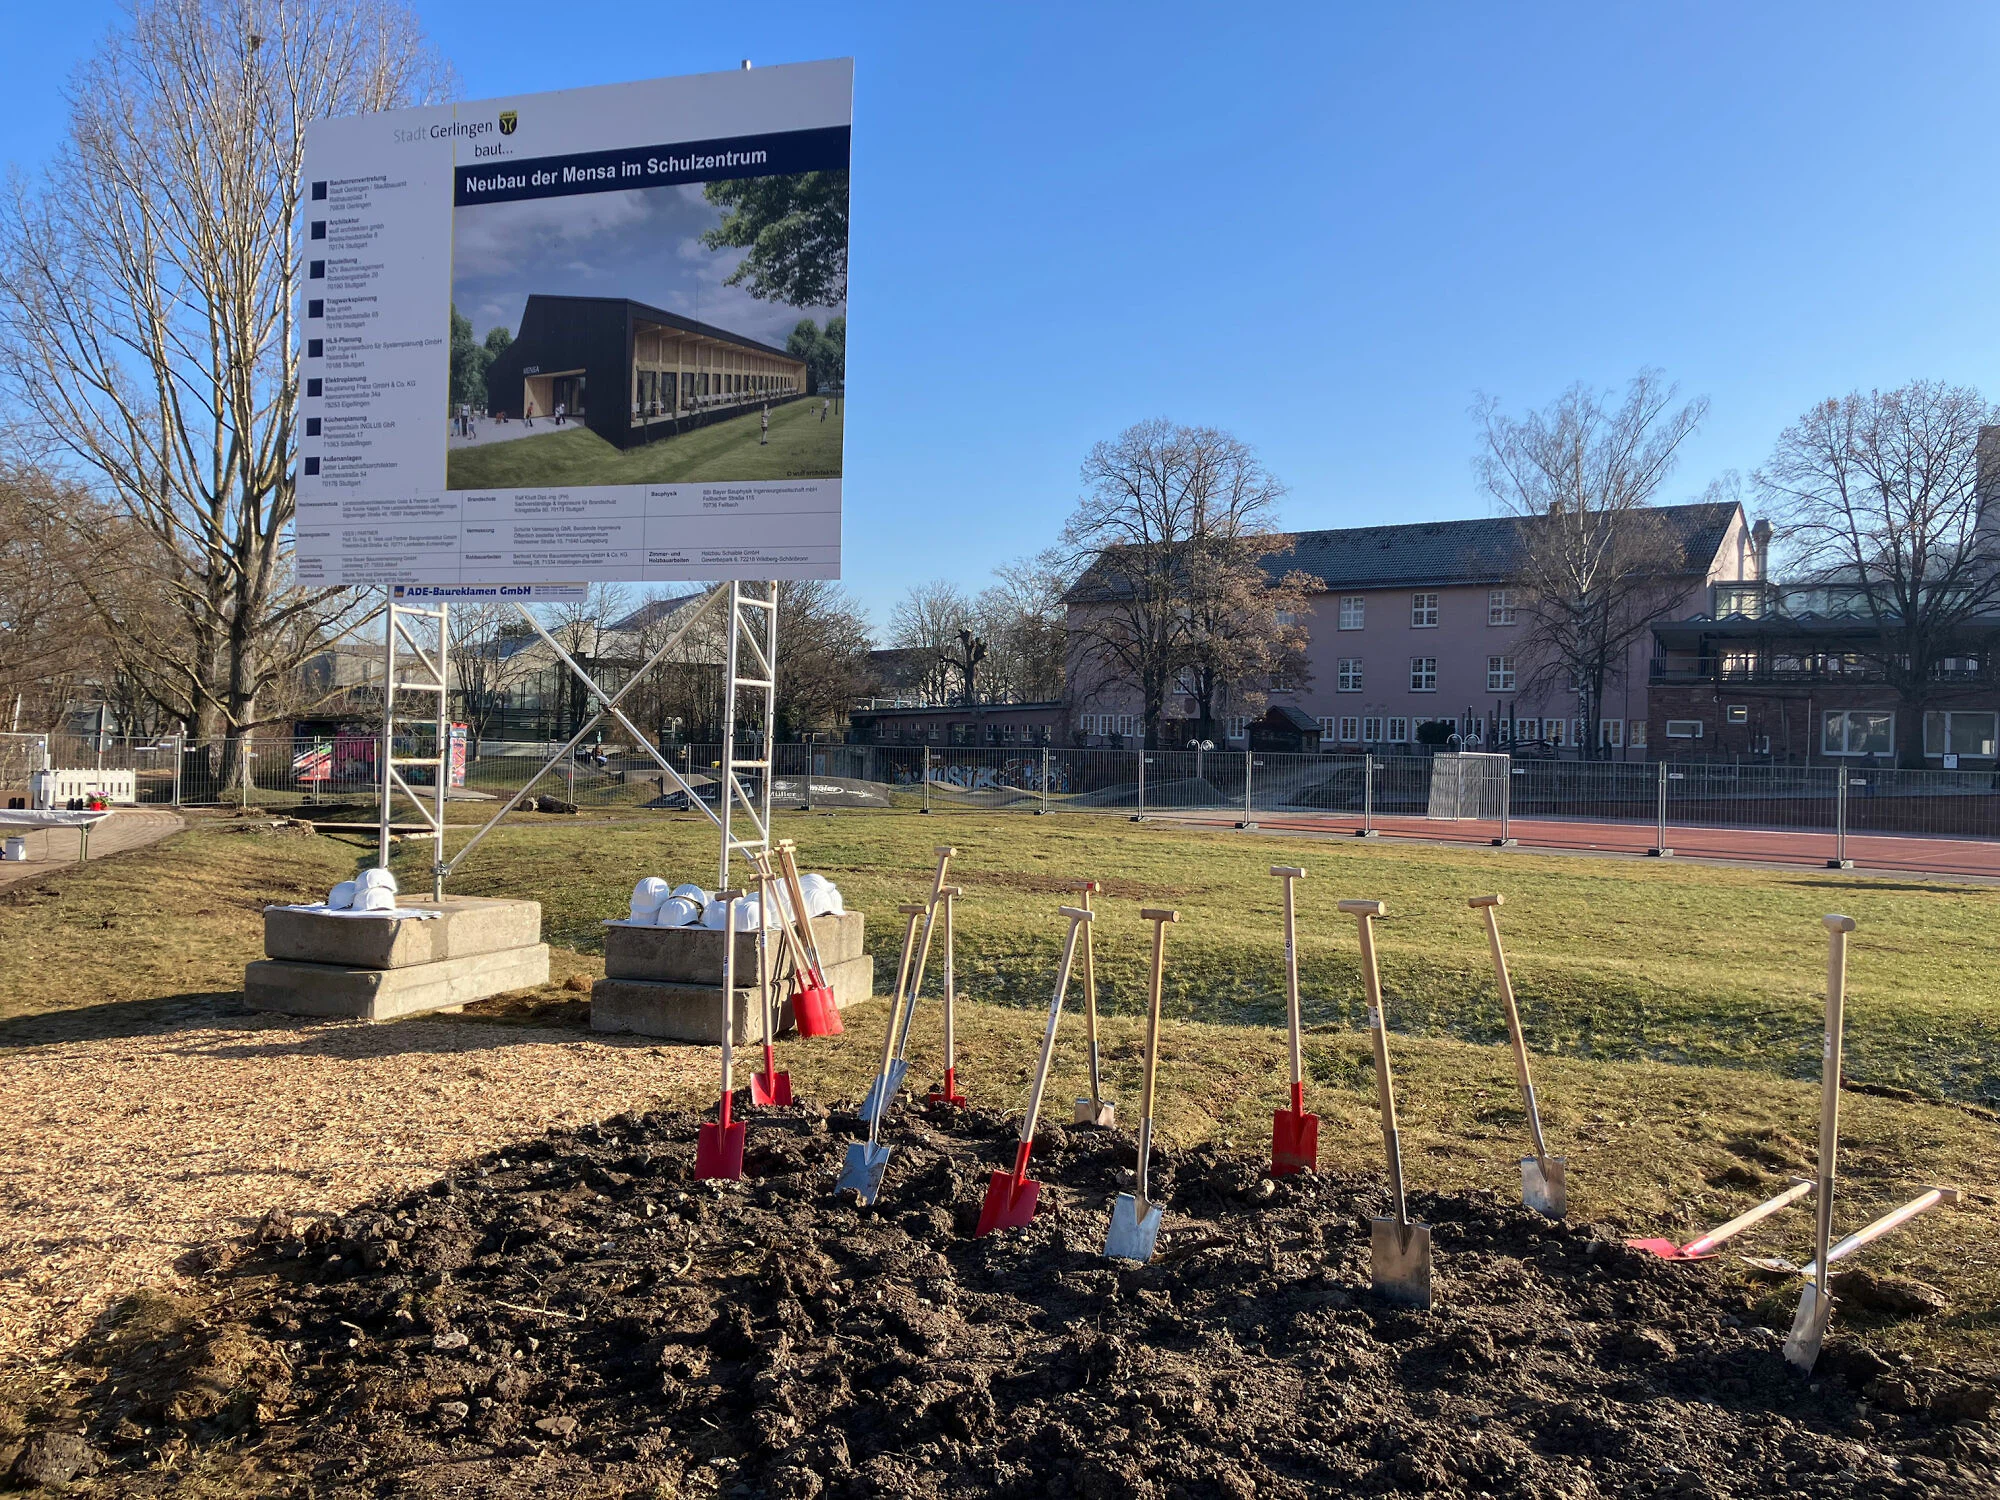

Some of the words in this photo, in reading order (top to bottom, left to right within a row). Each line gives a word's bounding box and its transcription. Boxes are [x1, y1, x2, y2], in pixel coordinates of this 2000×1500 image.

[394, 127, 427, 142] Stadt
[430, 118, 494, 140] Gerlingen
[474, 142, 514, 158] baut...
[466, 174, 527, 193] Neubau
[532, 169, 558, 186] der
[563, 166, 616, 184] Mensa
[622, 161, 641, 177] im
[647, 150, 767, 174] Schulzentrum
[406, 586, 497, 596] ADE-Baureklamen
[500, 586, 532, 596] GmbH
